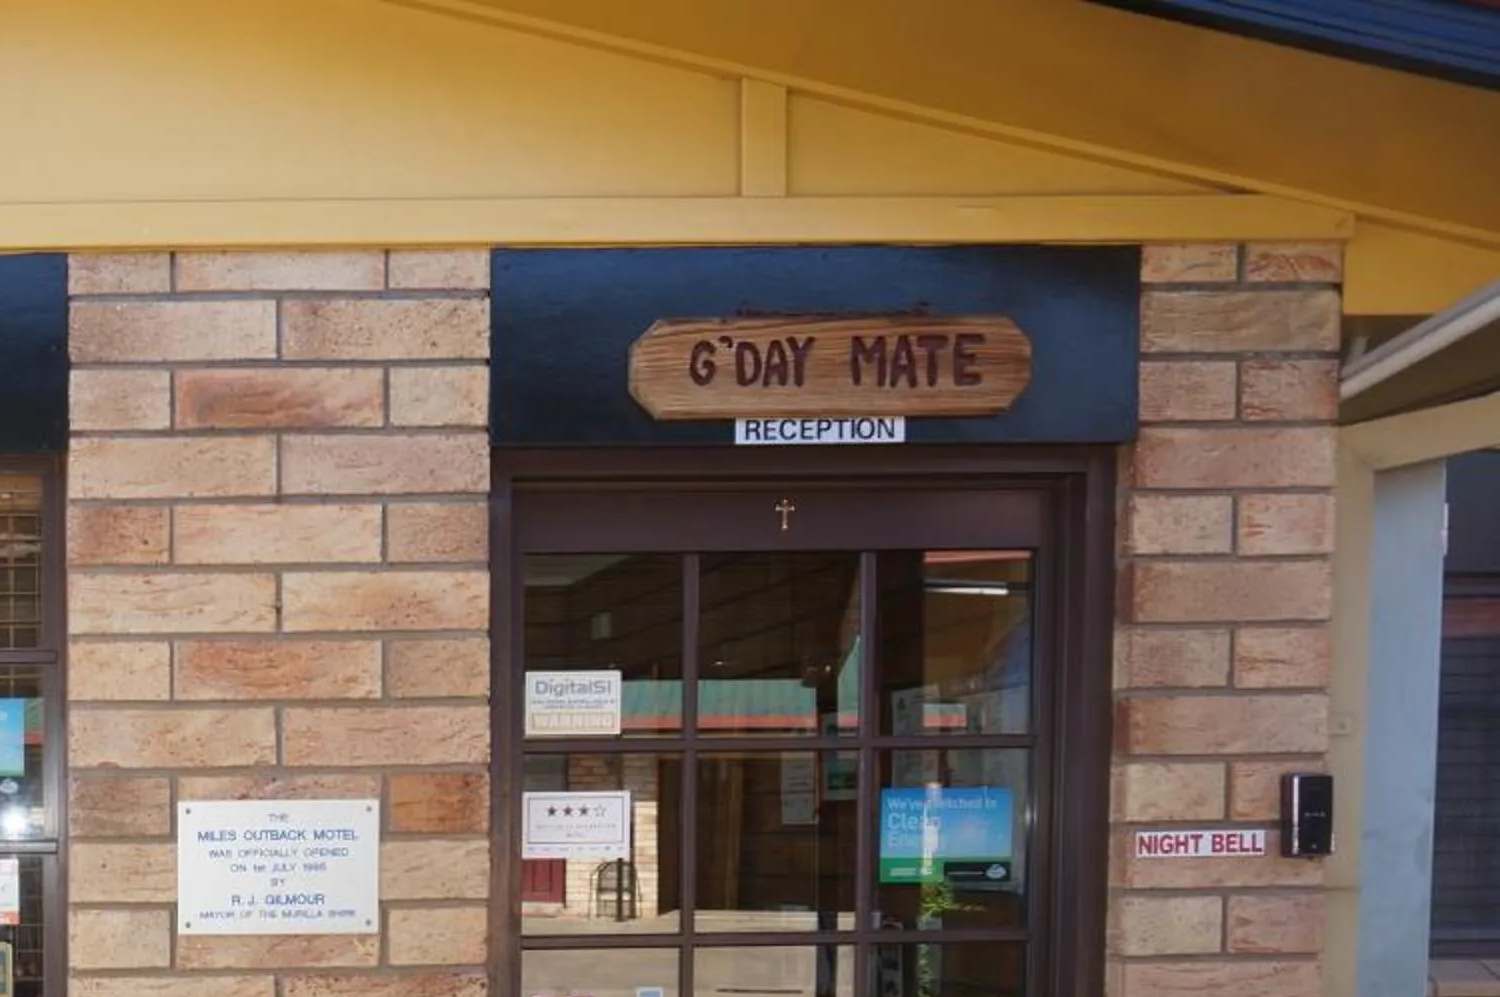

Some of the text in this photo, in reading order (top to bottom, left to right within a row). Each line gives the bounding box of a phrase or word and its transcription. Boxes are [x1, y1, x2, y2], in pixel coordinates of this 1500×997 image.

[850, 333, 985, 388] MATE
[744, 418, 896, 441] RECEPTION
[197, 829, 358, 842] MILES OUTBACK MOTEL
[1138, 833, 1263, 854] NIGHT BELL
[209, 847, 349, 859] WAS OFFICIALLY OPENED
[230, 863, 247, 873] ON
[273, 863, 298, 873] JULY
[271, 878, 286, 888] BY
[265, 894, 325, 906] GILMOUR
[258, 909, 278, 919] THE
